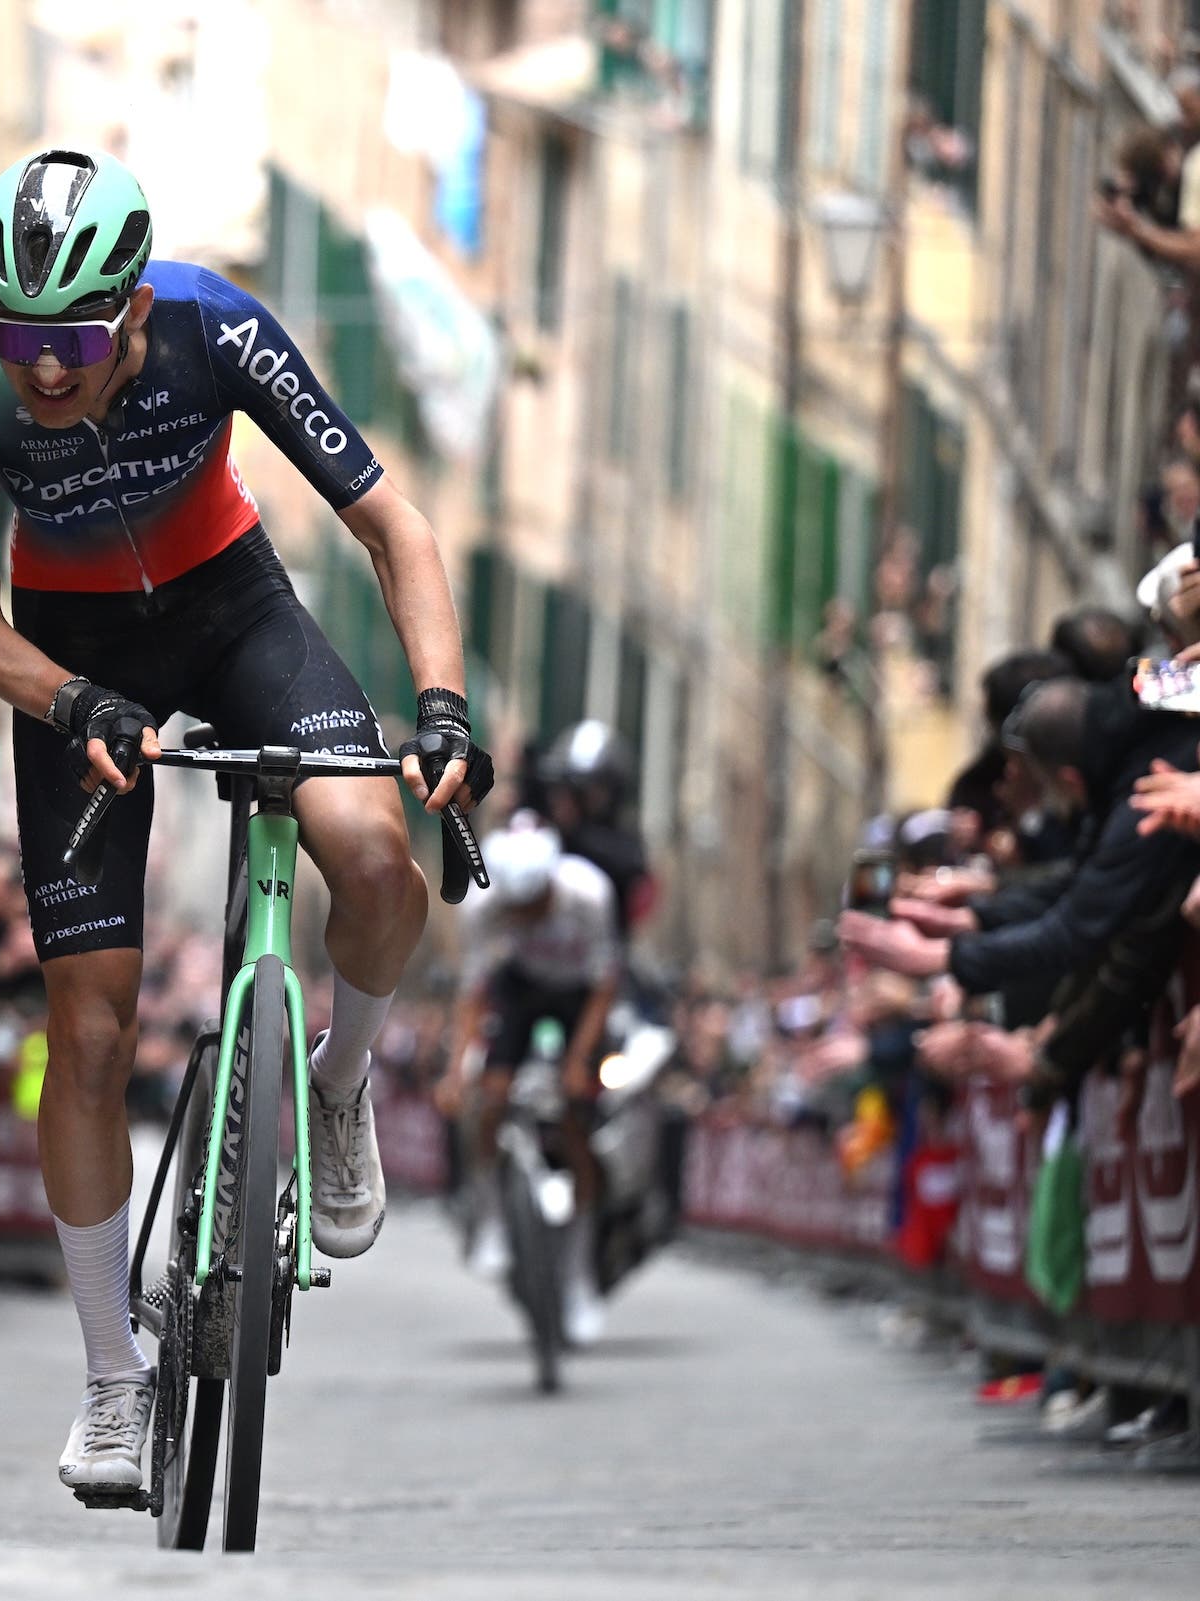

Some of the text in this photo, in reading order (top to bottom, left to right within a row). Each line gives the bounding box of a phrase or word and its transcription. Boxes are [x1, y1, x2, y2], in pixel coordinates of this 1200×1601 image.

[216, 317, 348, 455] Adecco
[157, 412, 208, 433] RYSEL
[20, 436, 85, 451] ARMAND
[27, 446, 80, 463] THIERY
[290, 709, 367, 733] ARMAND
[299, 717, 361, 737] THIERY
[333, 744, 370, 755] CGM
[68, 784, 108, 849] SRAM
[448, 802, 482, 867] SRAM
[35, 877, 81, 900] ARMA
[40, 884, 98, 908] THIERY
[56, 915, 127, 940] DECATHLON
